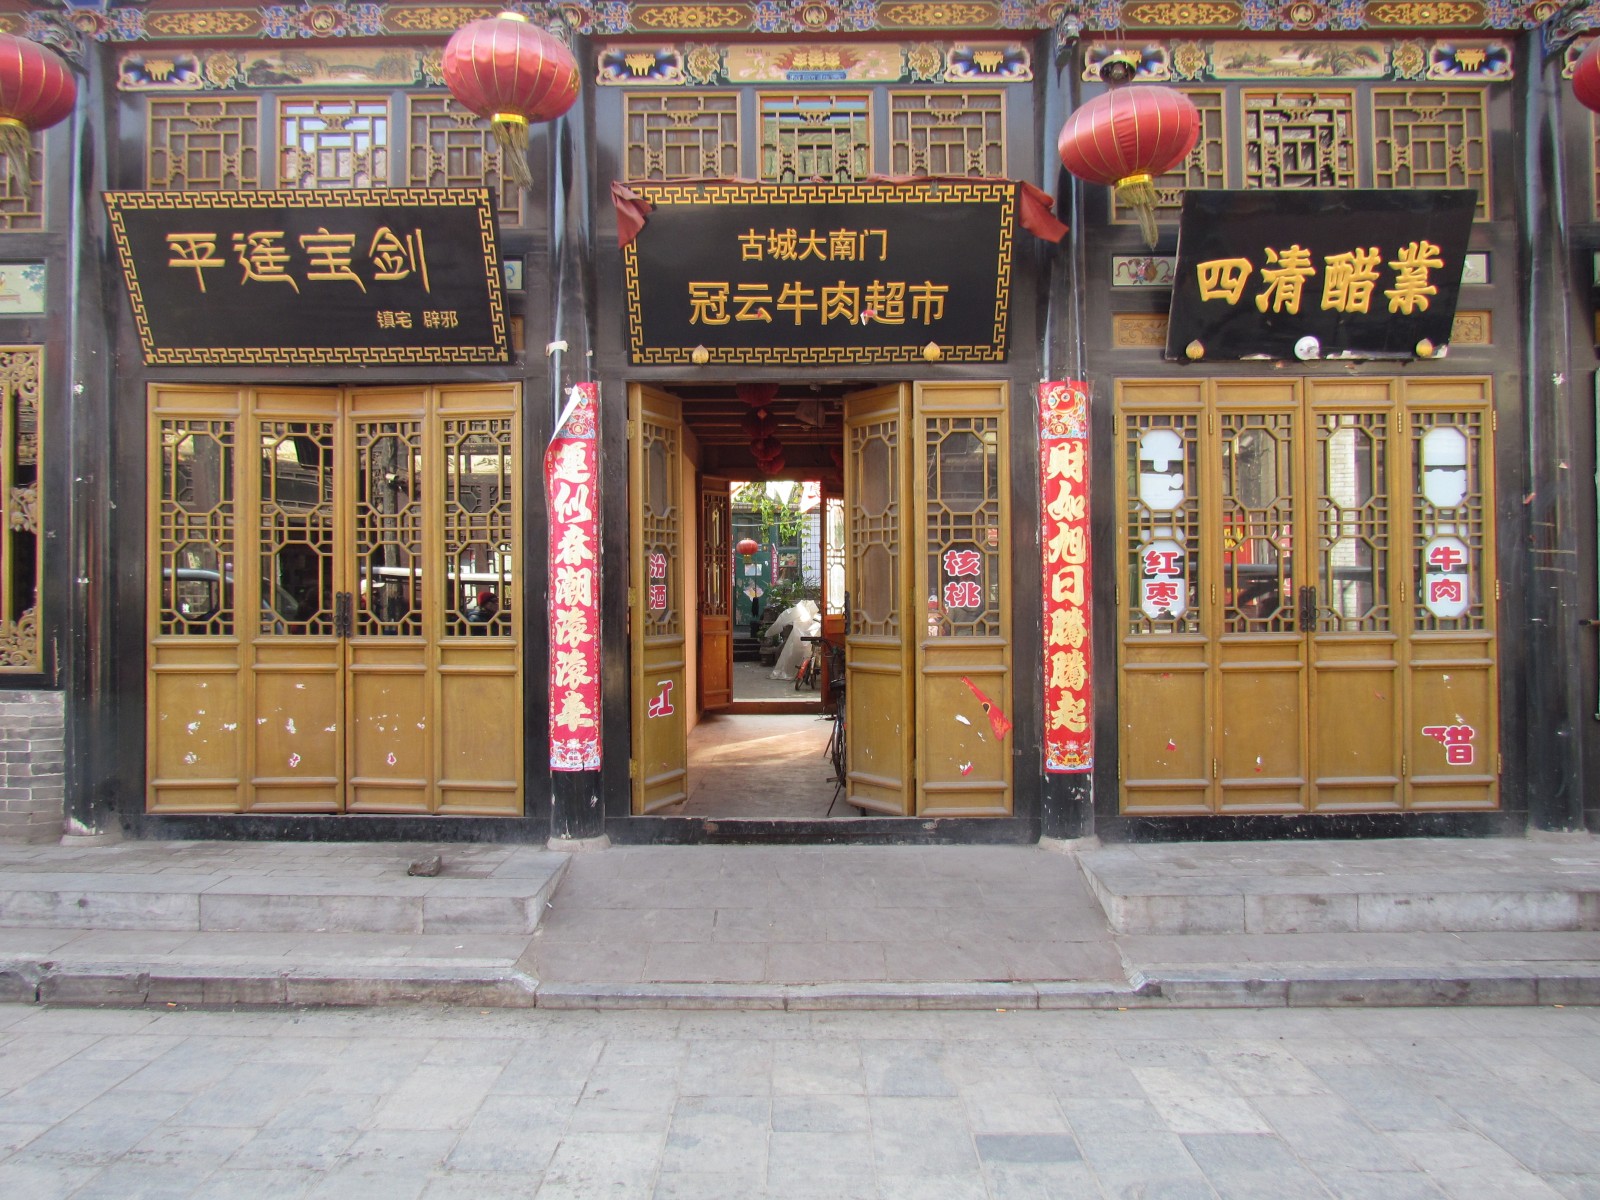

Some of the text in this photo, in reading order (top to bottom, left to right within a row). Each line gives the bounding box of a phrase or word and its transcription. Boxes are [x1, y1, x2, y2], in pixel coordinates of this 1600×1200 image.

[166, 226, 431, 294] 平遥宝剑
[738, 228, 888, 262] 古城大南门
[377, 310, 459, 329] 镇宅 辟邪
[688, 280, 949, 326] 冠云牛肉超市
[943, 550, 981, 607] 核桃
[1144, 550, 1181, 607] 红枣
[1430, 546, 1463, 603] 牛肉
